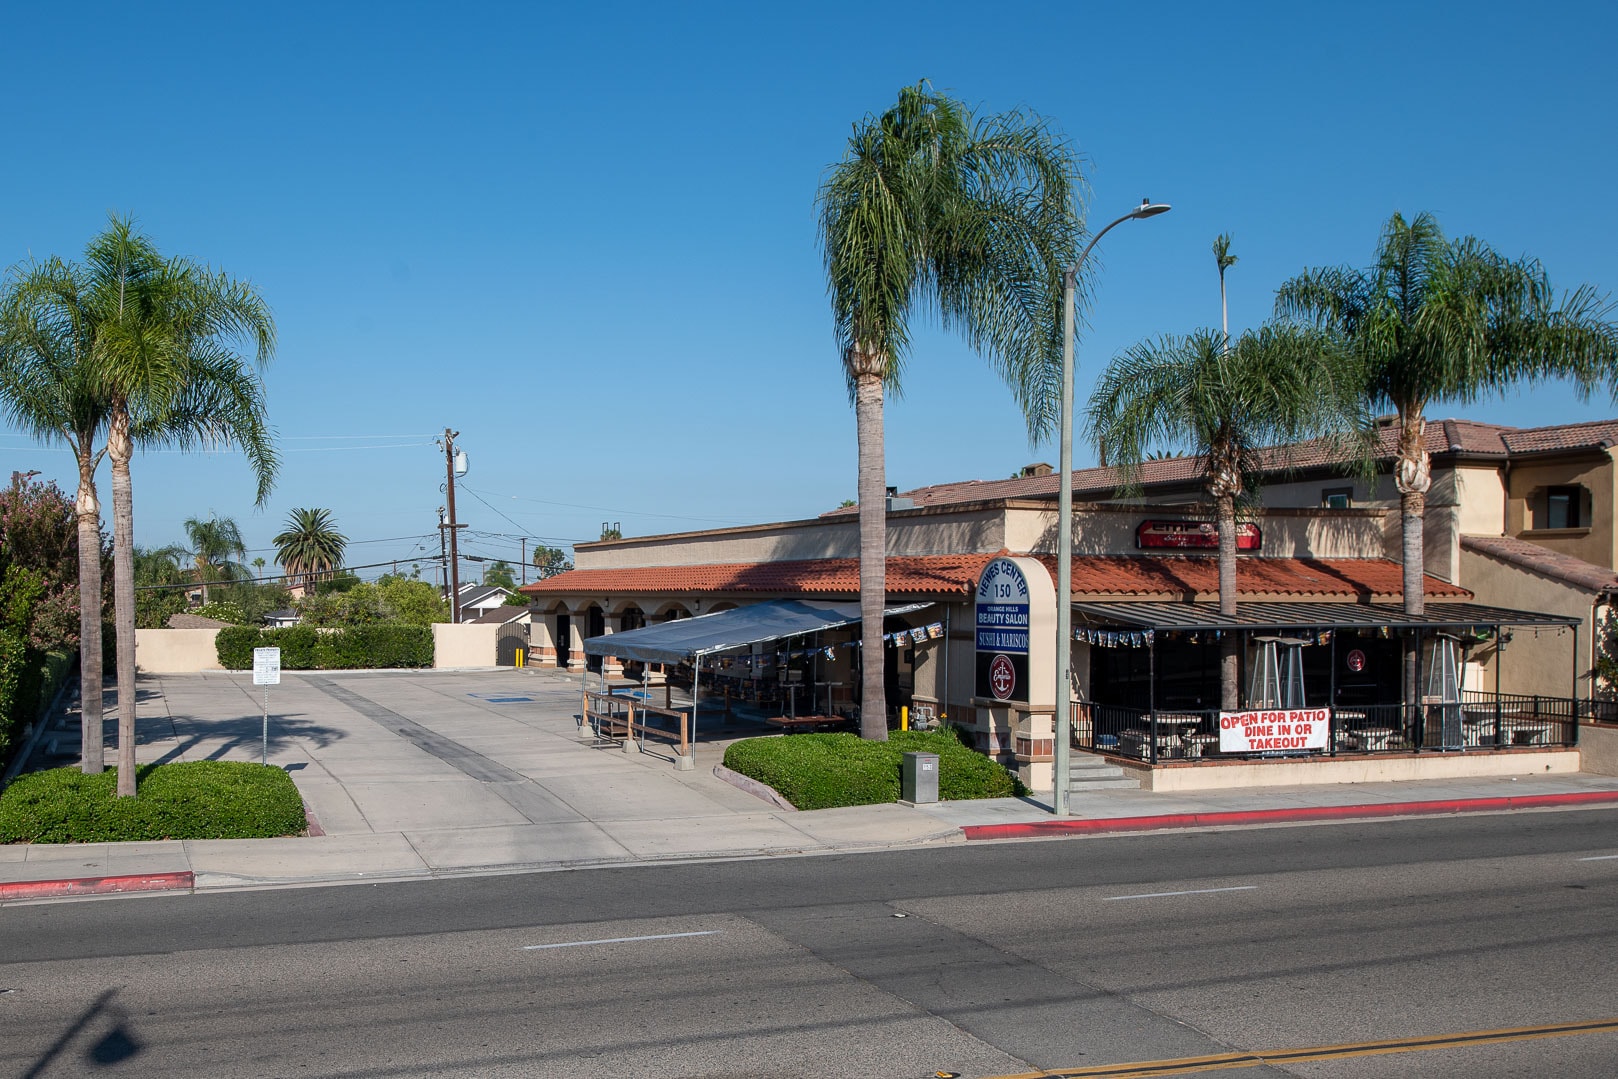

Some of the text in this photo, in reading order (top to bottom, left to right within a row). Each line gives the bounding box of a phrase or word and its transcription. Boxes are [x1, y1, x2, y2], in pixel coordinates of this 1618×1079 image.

[980, 561, 1027, 597] HEWES CENTER
[994, 584, 1011, 598] 150
[978, 613, 1028, 625] BEAUTY SALON
[979, 632, 1029, 648] SUSHI & MARISCOS
[1221, 710, 1326, 730] OPEN FOR PATIO
[1244, 723, 1312, 737] DINE IN OR
[1248, 736, 1308, 750] TAKEOUT
